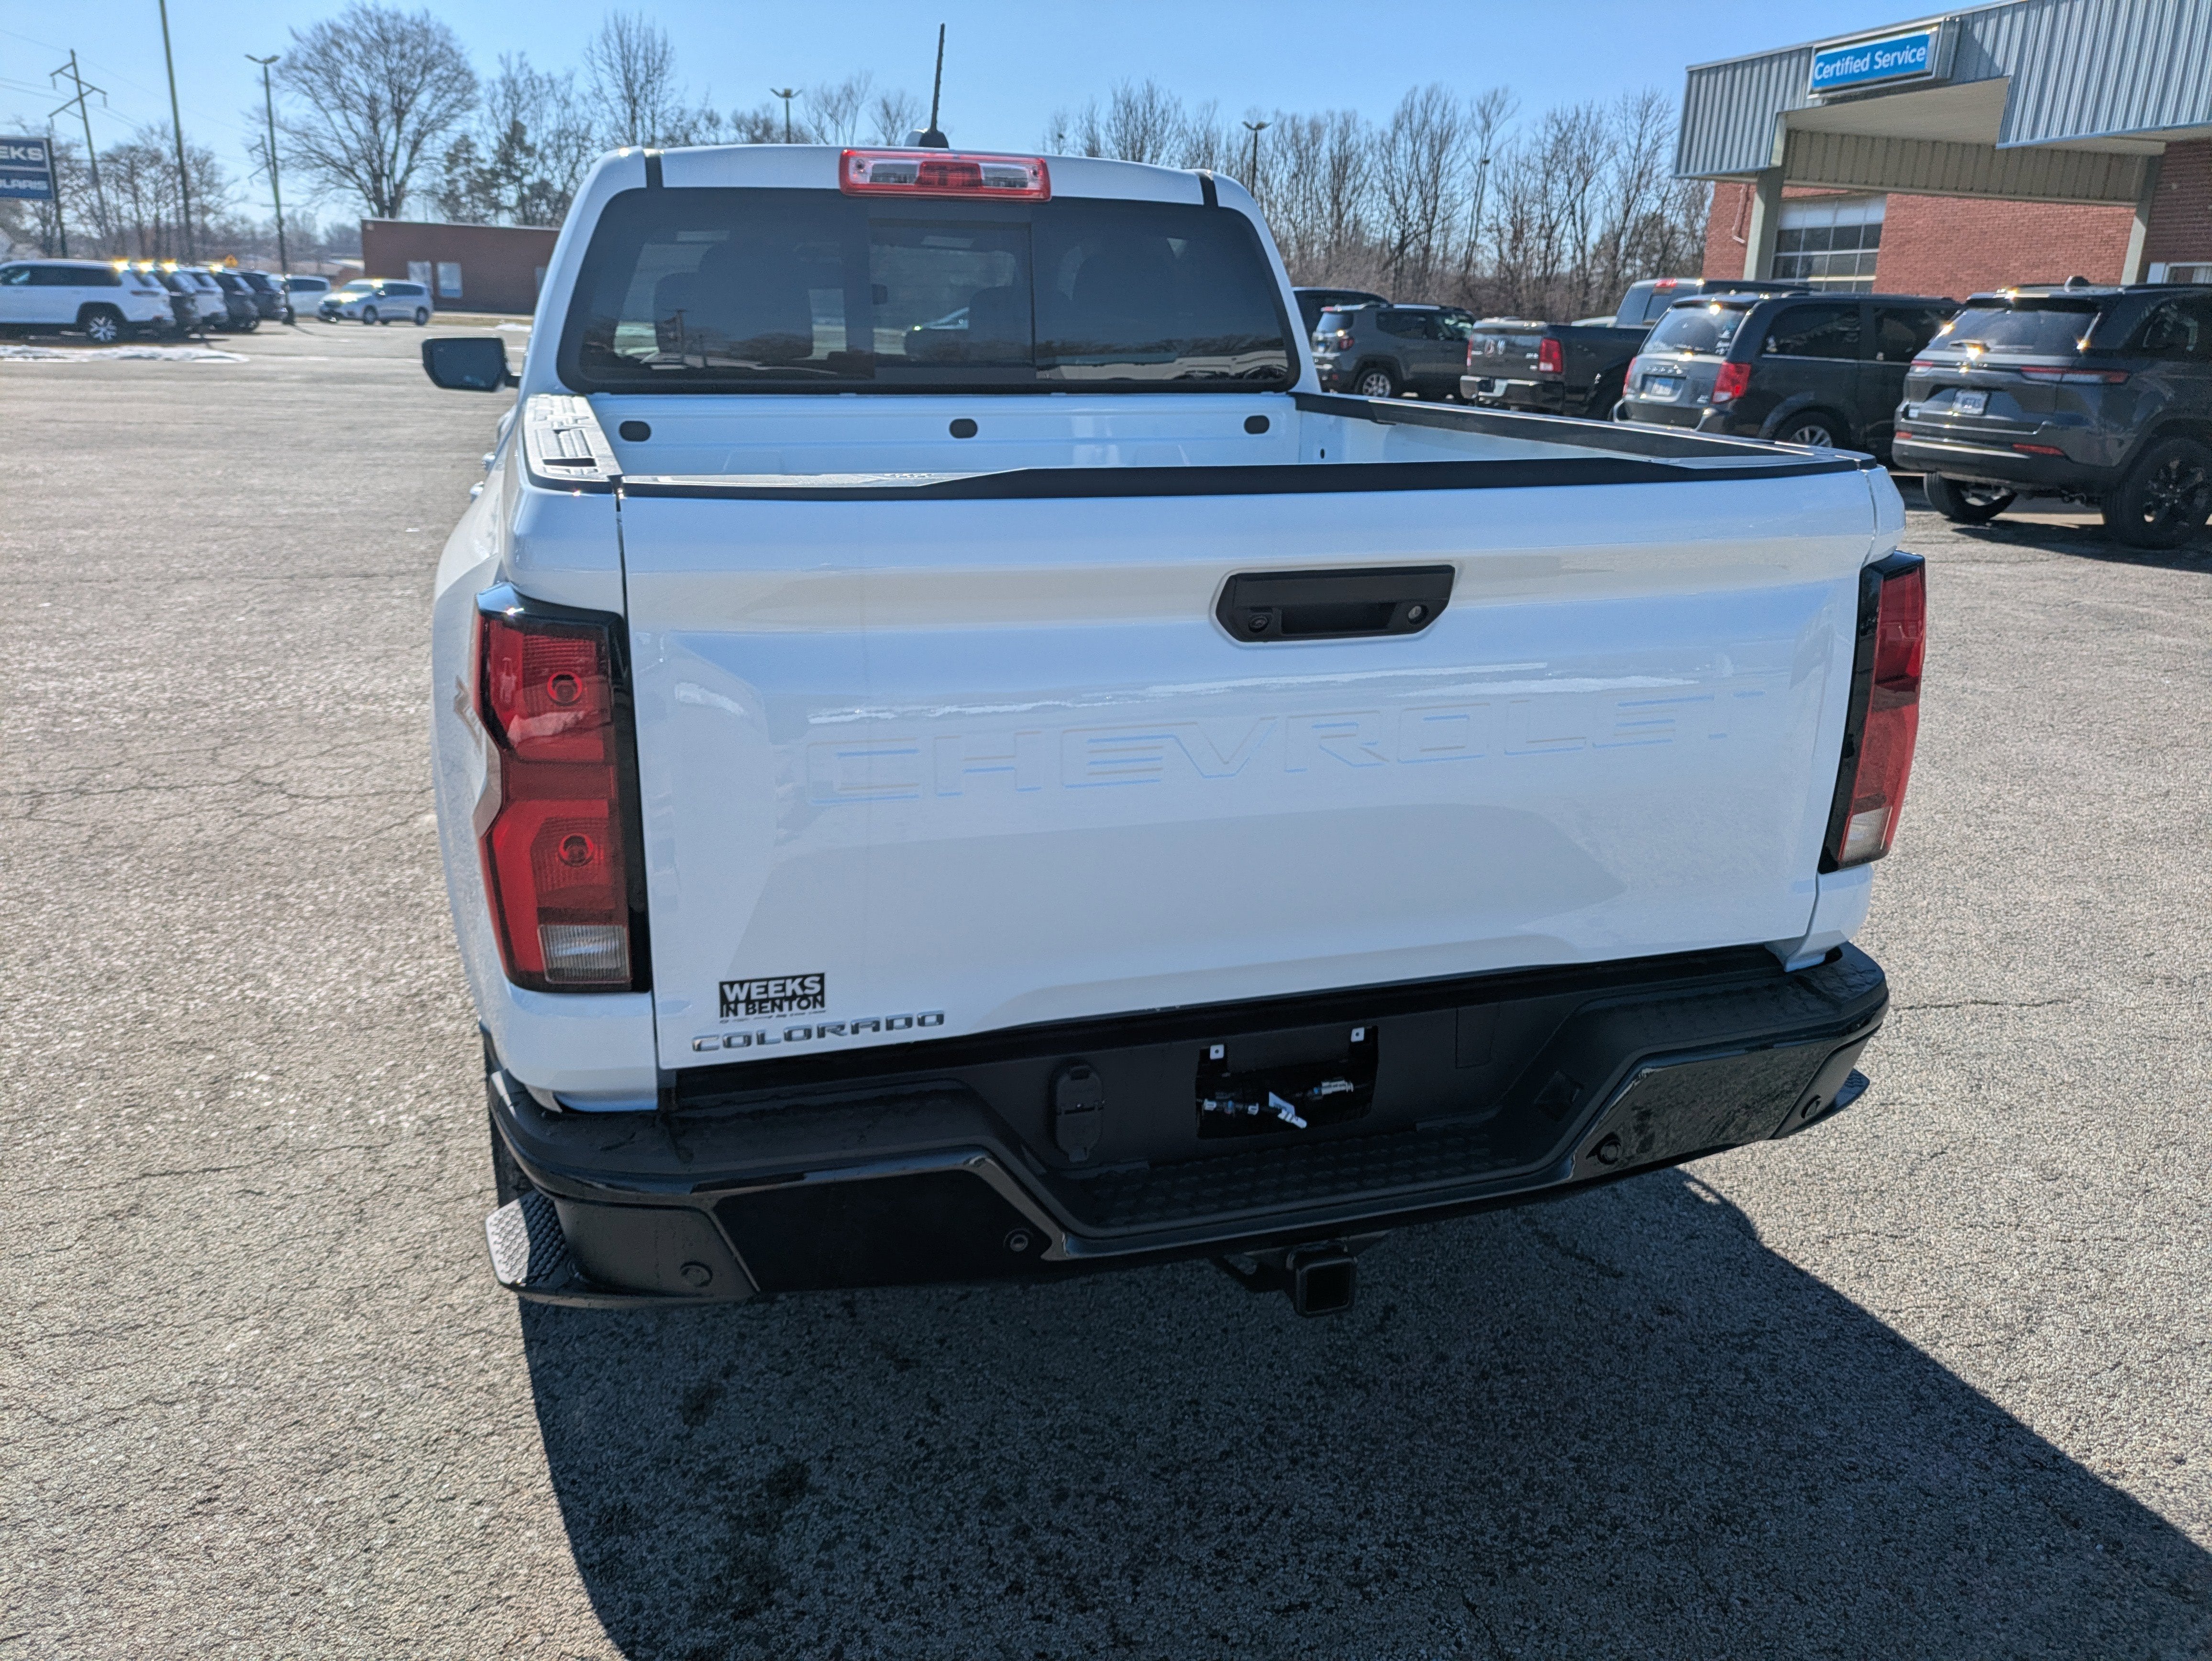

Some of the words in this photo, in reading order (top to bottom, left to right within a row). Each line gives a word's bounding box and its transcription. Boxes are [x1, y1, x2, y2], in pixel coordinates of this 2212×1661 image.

[1814, 52, 1871, 80] Certified
[1873, 45, 1926, 70] Service
[807, 684, 1767, 804] CHEVROLET
[722, 975, 821, 1002] WEEKS
[719, 1004, 738, 1018] IN
[745, 995, 825, 1016] BENTON
[692, 1010, 945, 1052] COLORADO
